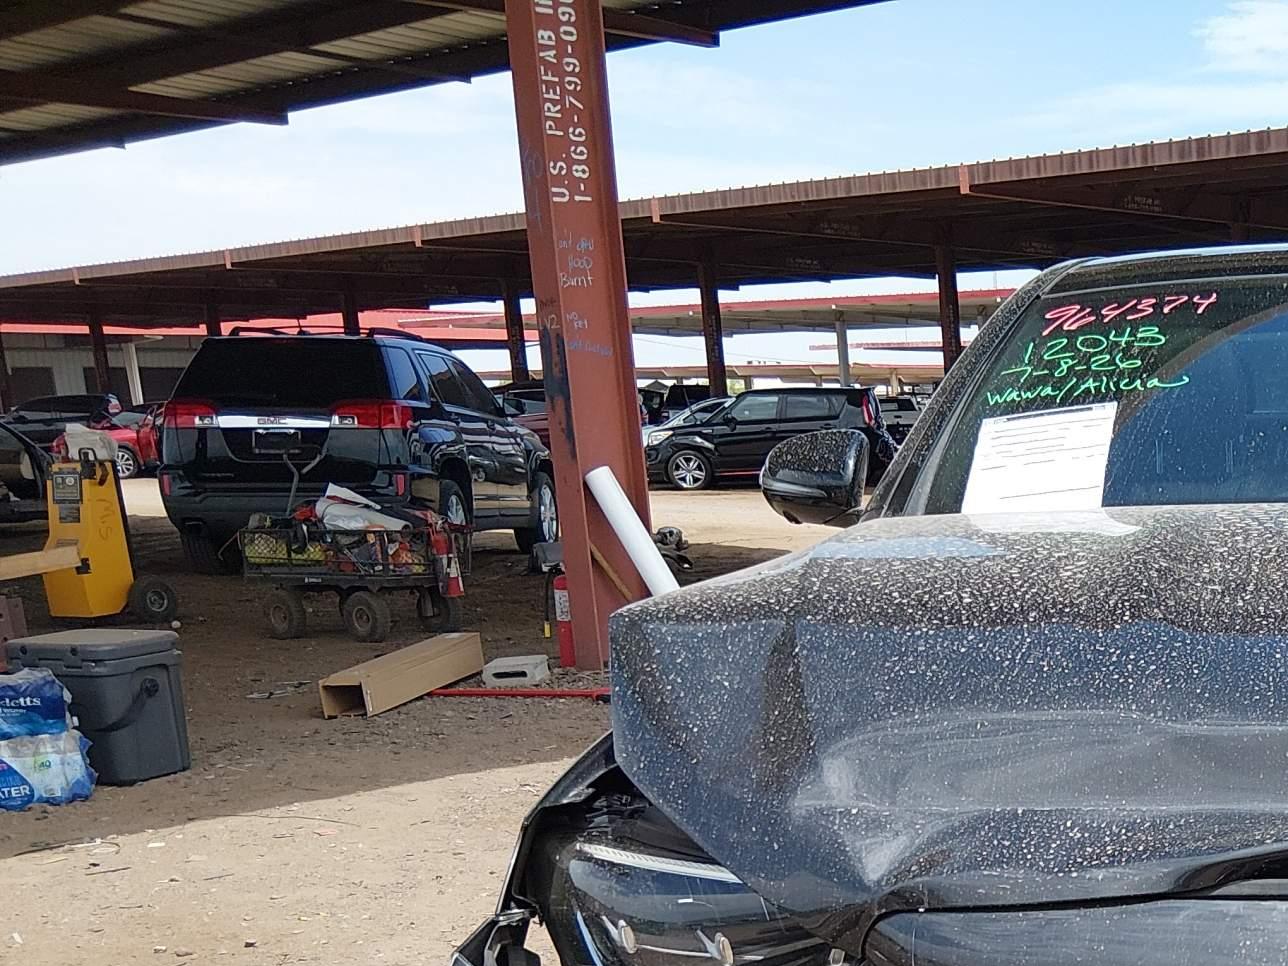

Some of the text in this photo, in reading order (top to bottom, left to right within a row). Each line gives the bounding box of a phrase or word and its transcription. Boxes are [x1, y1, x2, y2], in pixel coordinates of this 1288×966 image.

[537, 29, 564, 136] PREFAB
[557, 0, 593, 202] 1-866-799-09
[549, 153, 570, 202] U.S.
[1042, 292, 1217, 336] 964374
[1024, 326, 1166, 364] 12043
[1001, 353, 1142, 383] 7-8-26
[257, 417, 288, 425] GMC
